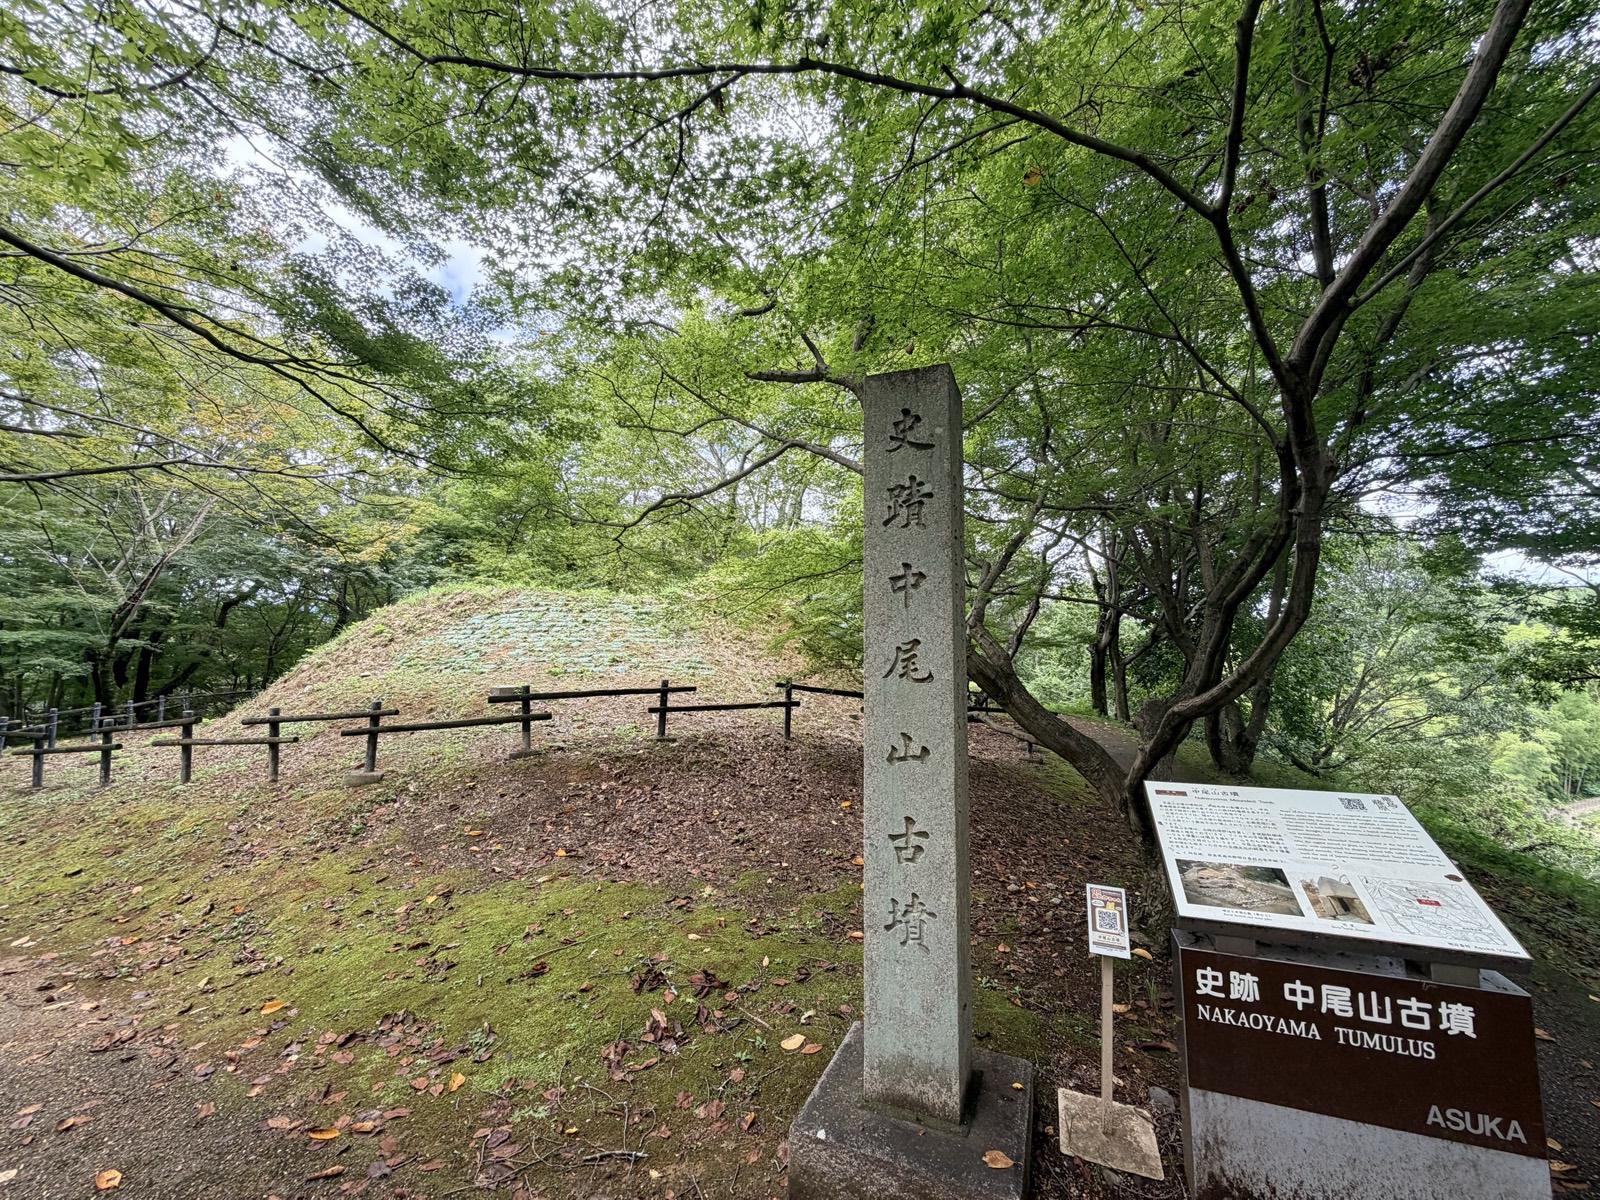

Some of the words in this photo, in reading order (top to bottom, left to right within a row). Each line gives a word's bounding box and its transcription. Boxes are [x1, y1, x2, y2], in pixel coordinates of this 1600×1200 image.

[1196, 966, 1260, 1003] 史跡
[1283, 979, 1477, 1040] 中尾山古墳
[1197, 1004, 1322, 1041] NAKAOYAMA
[1334, 1027, 1436, 1060] TUMULUS
[1426, 1104, 1528, 1144] ASUKA
